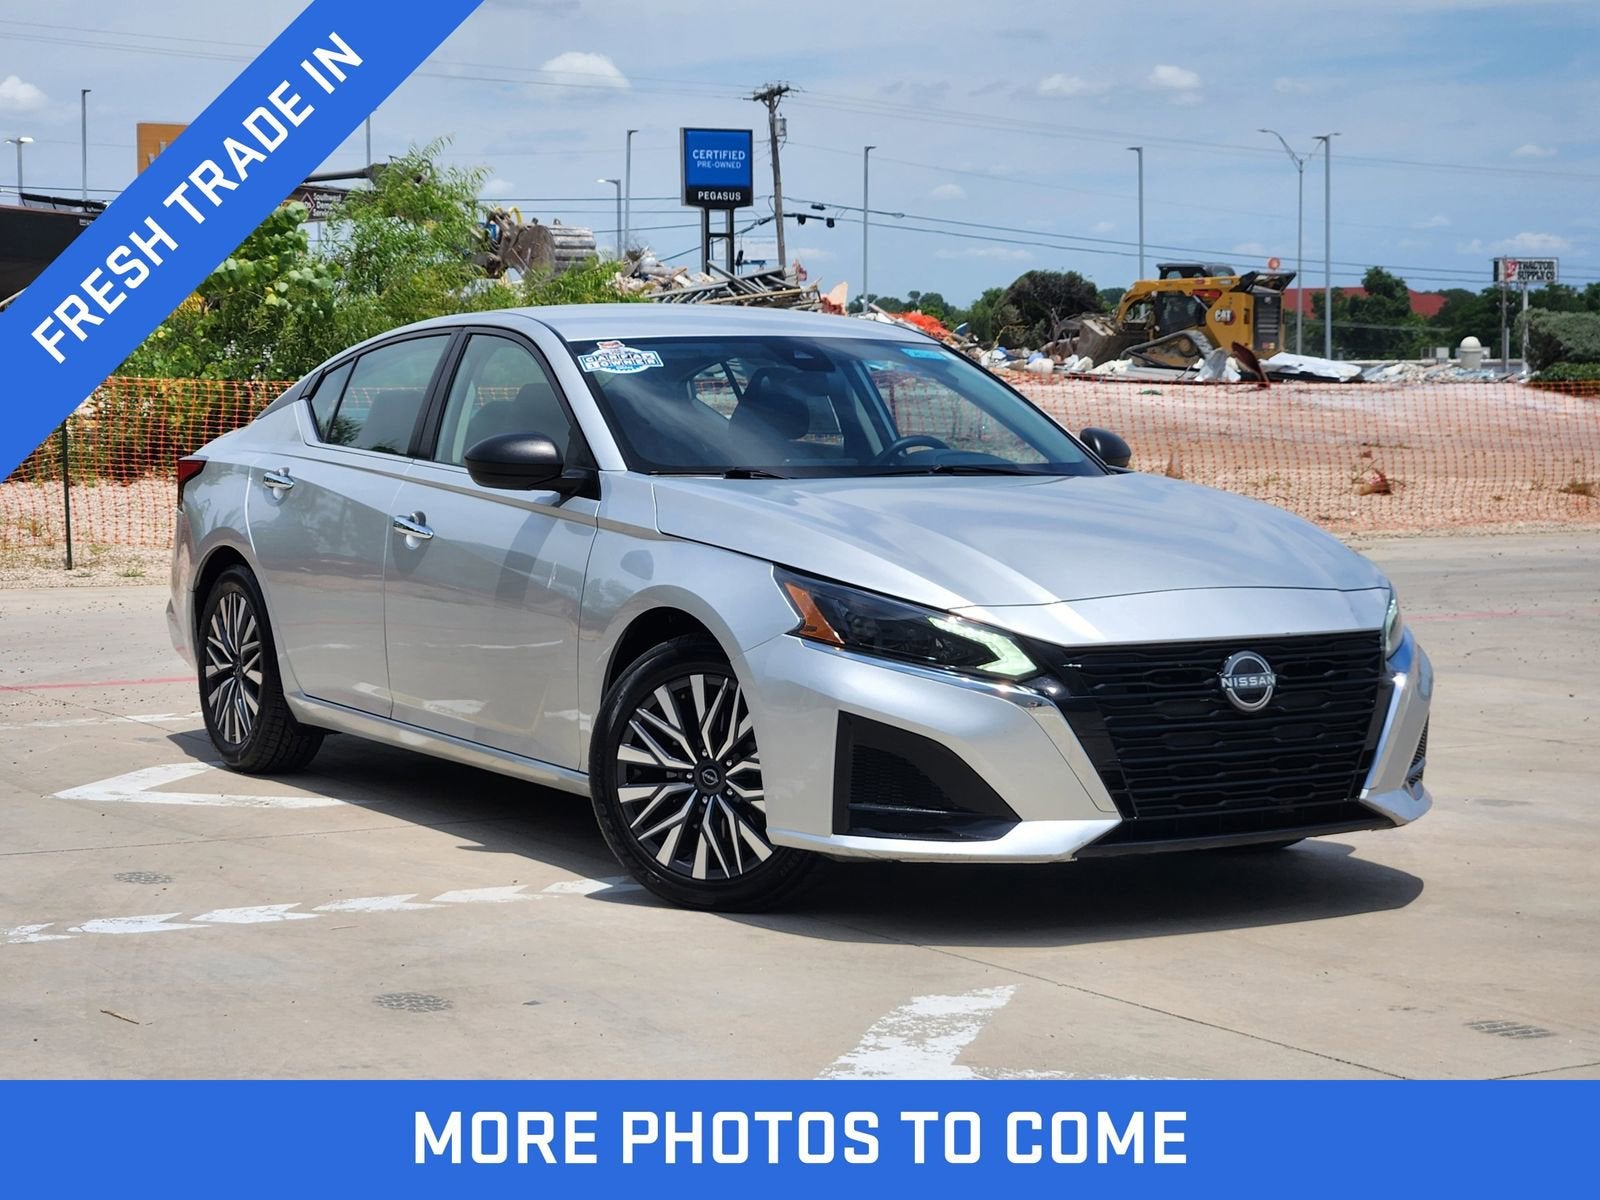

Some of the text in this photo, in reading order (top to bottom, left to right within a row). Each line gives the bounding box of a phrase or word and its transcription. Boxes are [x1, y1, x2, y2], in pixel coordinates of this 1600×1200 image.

[692, 149, 746, 160] CERTIFIED
[696, 160, 742, 169] PRE-OWNED
[697, 191, 742, 201] PEGASUS
[1517, 261, 1555, 270] TRACTOR
[1517, 270, 1545, 280] SUPPLY
[1215, 309, 1231, 322] CAT
[1221, 675, 1276, 688] NISSAN
